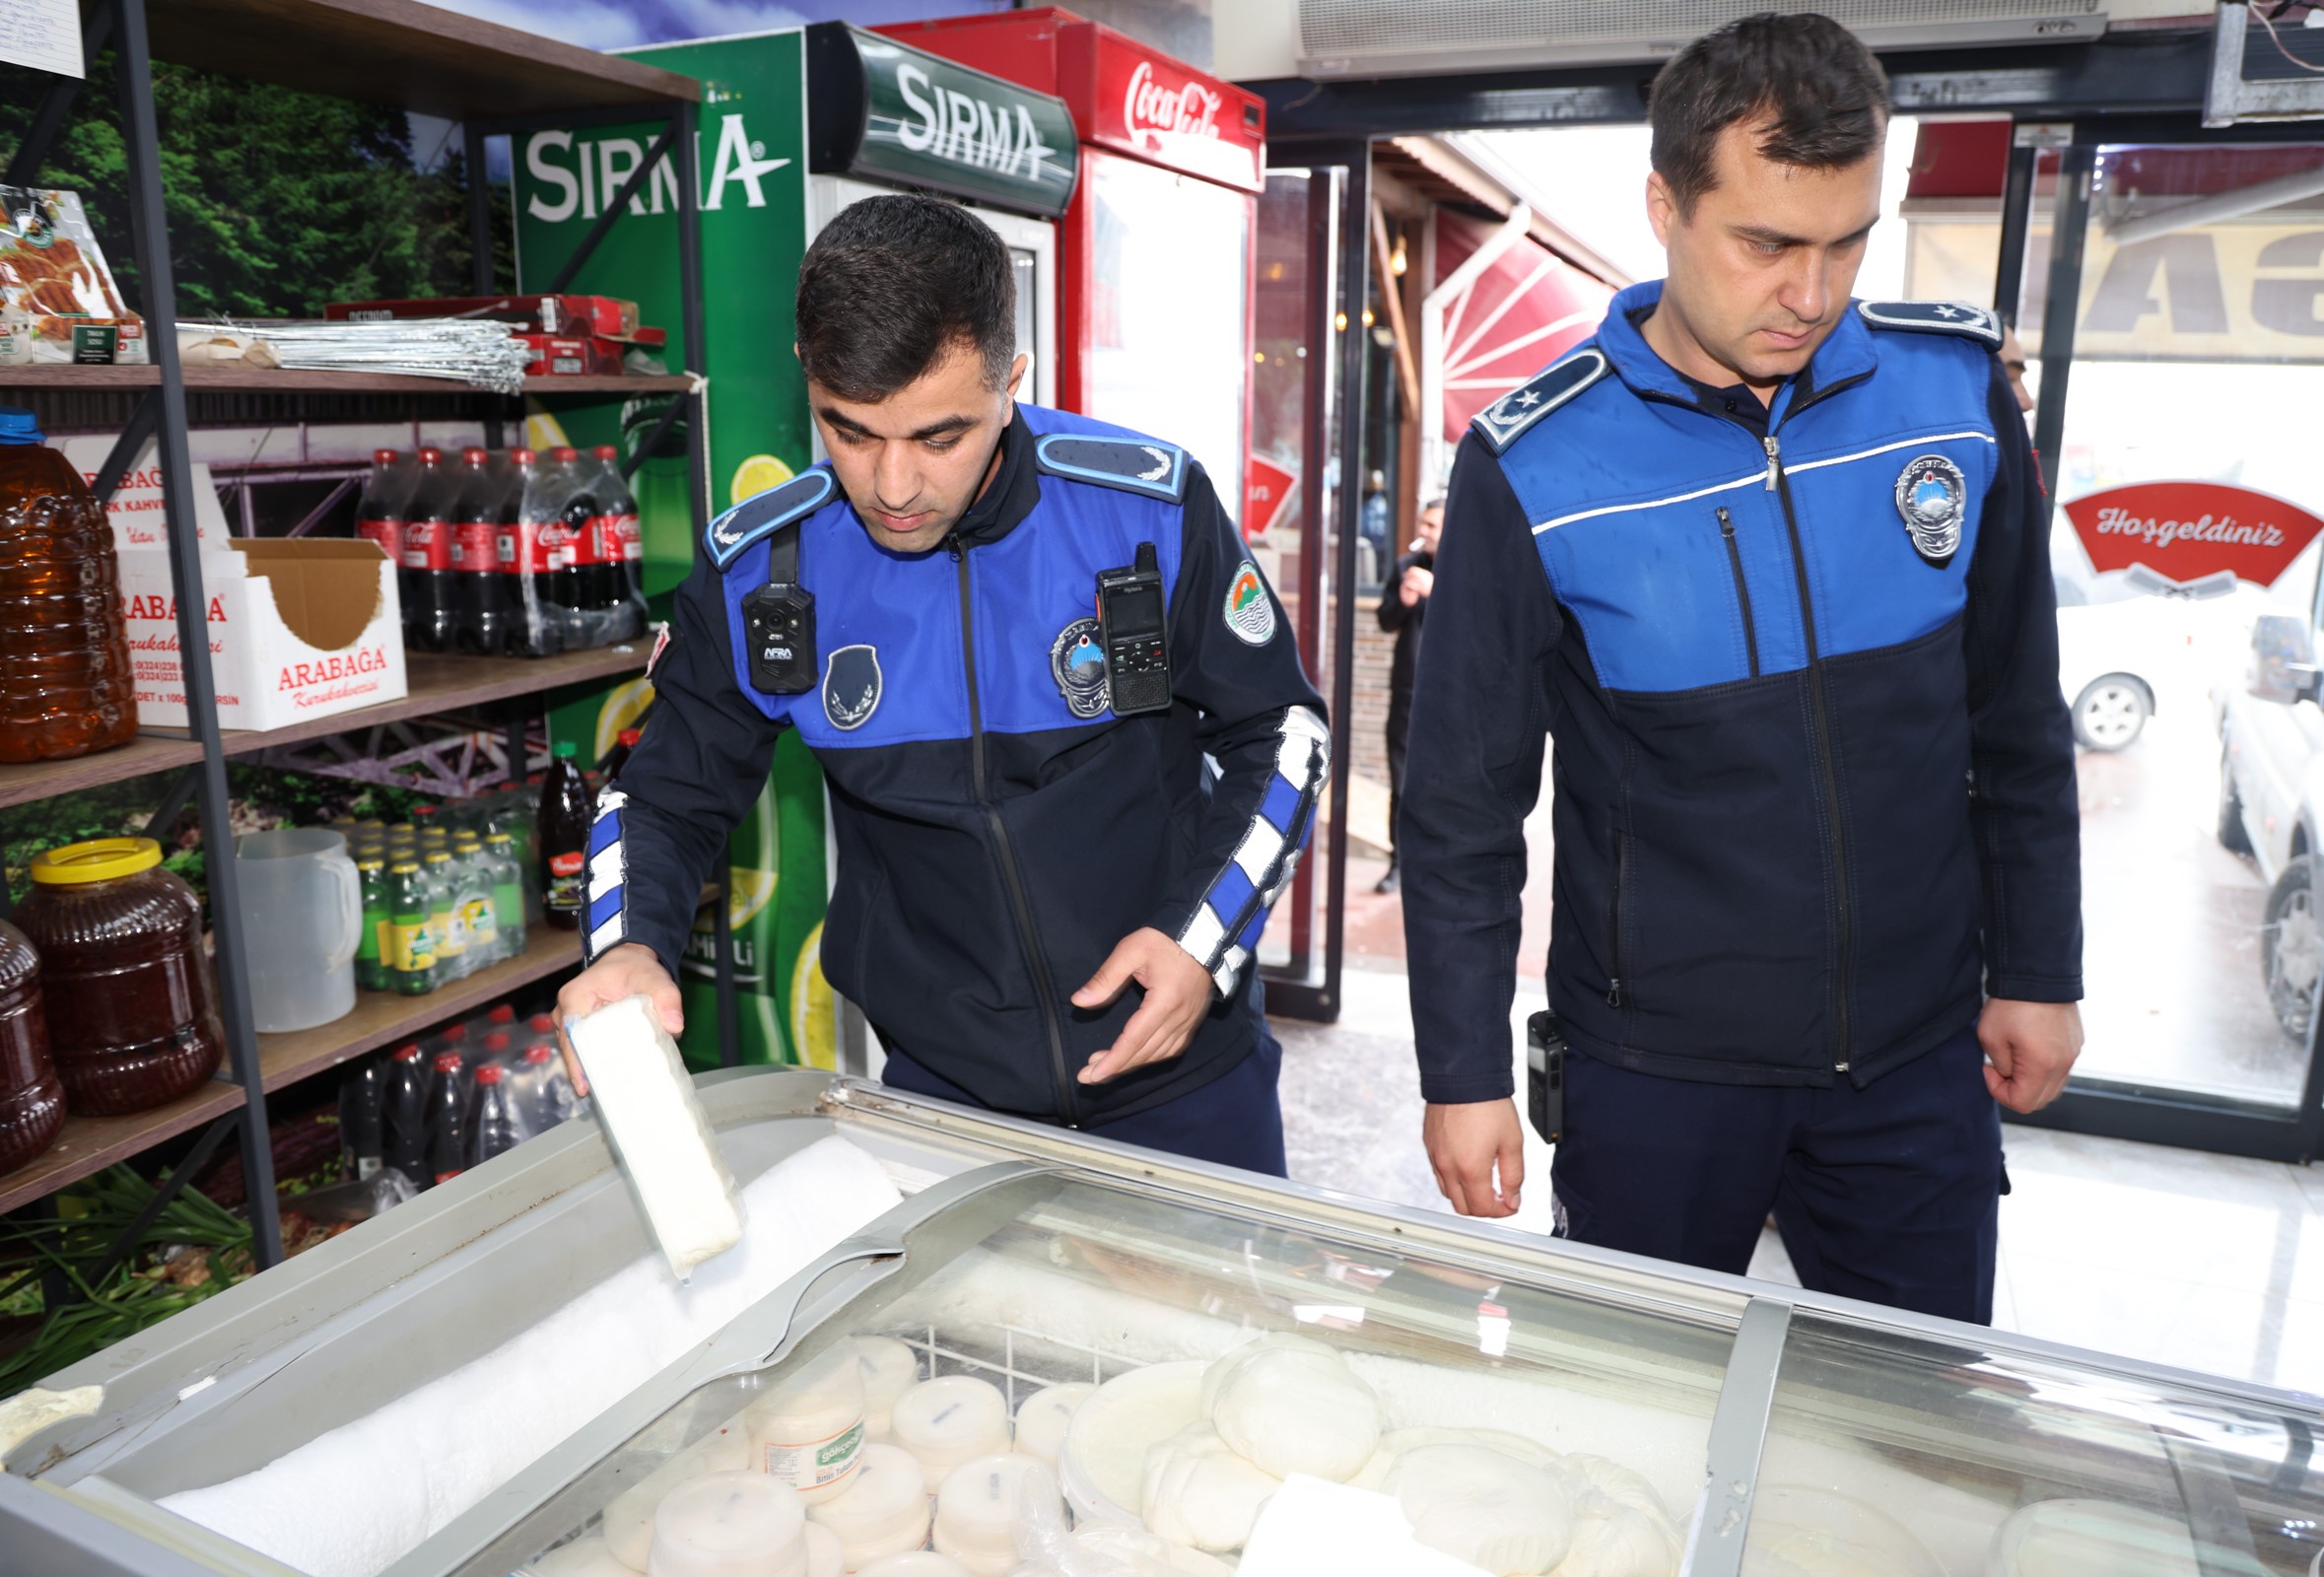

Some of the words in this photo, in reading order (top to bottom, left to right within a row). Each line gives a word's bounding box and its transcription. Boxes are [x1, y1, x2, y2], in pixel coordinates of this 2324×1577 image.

[896, 62, 1057, 182] SIRMA
[2096, 507, 2286, 548] Hoşgeldiniz
[278, 647, 387, 692] ARABAĞA
